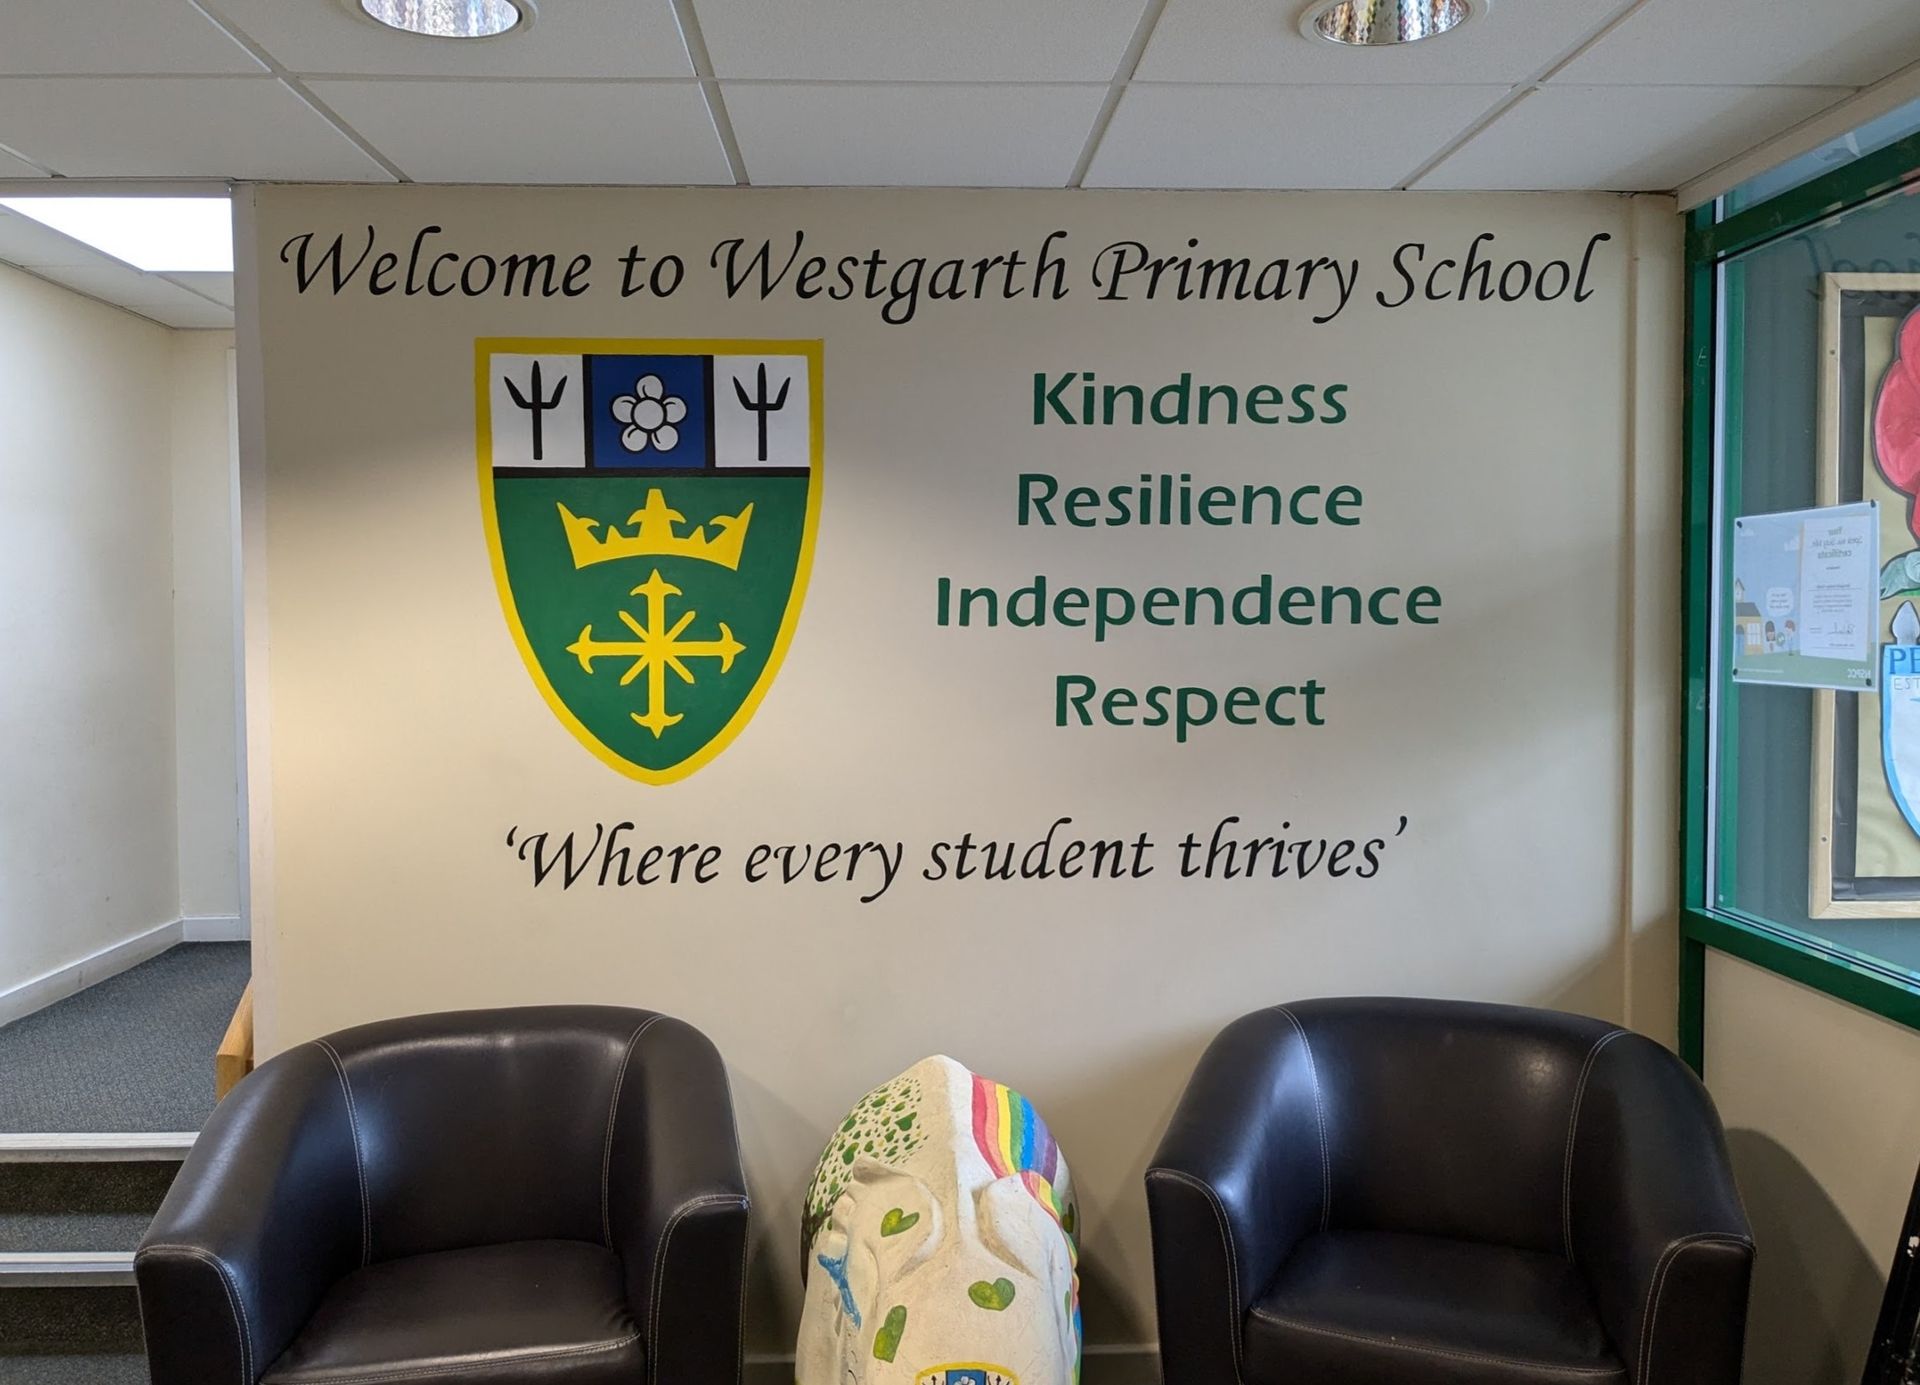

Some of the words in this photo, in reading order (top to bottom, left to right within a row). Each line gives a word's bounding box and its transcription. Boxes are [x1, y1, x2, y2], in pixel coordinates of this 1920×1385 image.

[280, 224, 592, 298] Welcome
[617, 244, 685, 298] to
[709, 229, 1070, 326] Westgarth
[1091, 237, 1359, 325] Primary
[1375, 232, 1612, 308] School
[1033, 372, 1349, 426] Kindness
[1018, 473, 1363, 528] Resilience
[936, 574, 1443, 642] Independence
[1055, 675, 1326, 743] Respect
[506, 821, 722, 890] ‘Where
[745, 841, 903, 904] every
[922, 817, 1155, 881] student
[1178, 815, 1409, 880] thrives’
